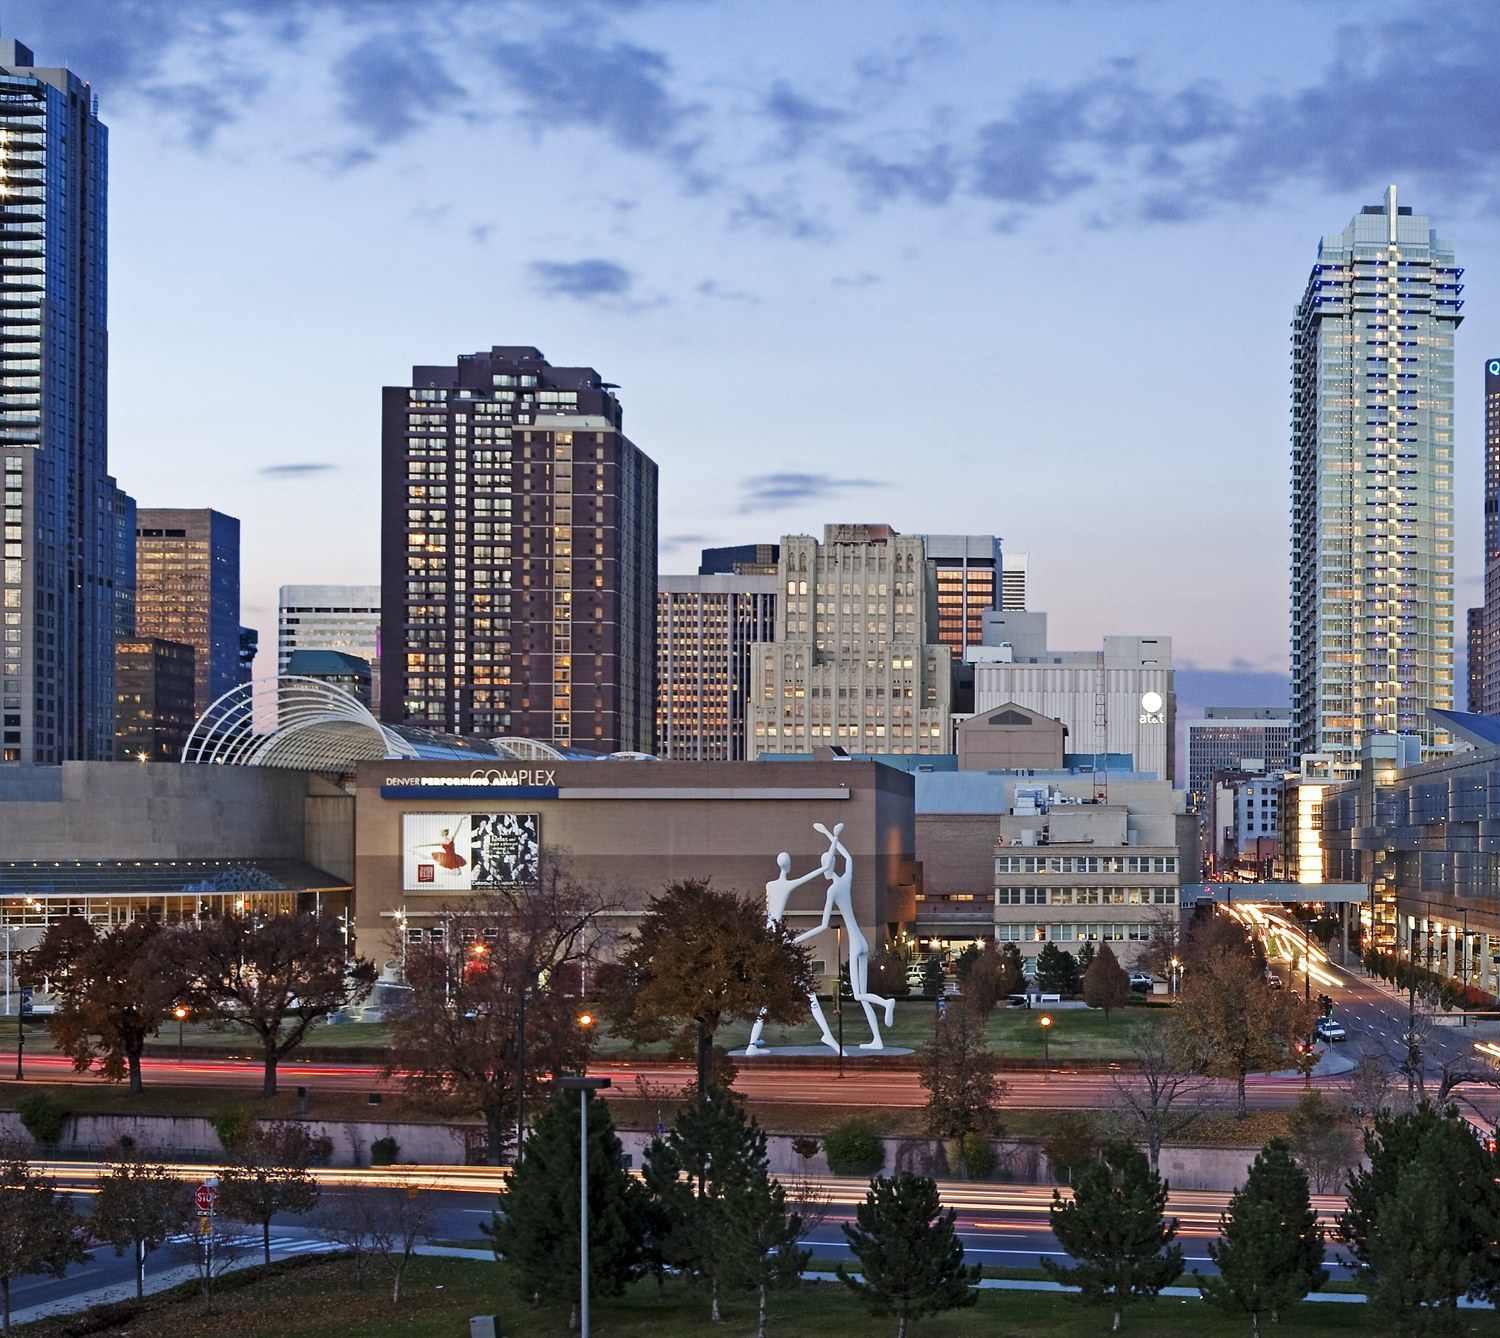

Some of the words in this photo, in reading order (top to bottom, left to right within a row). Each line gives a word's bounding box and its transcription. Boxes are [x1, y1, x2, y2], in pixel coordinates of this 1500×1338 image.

[386, 777, 420, 786] DENVER
[421, 777, 490, 787] PERFORMING
[470, 769, 556, 786] COMPLEX
[491, 777, 518, 787] ARTS
[197, 1192, 217, 1202] STOP
